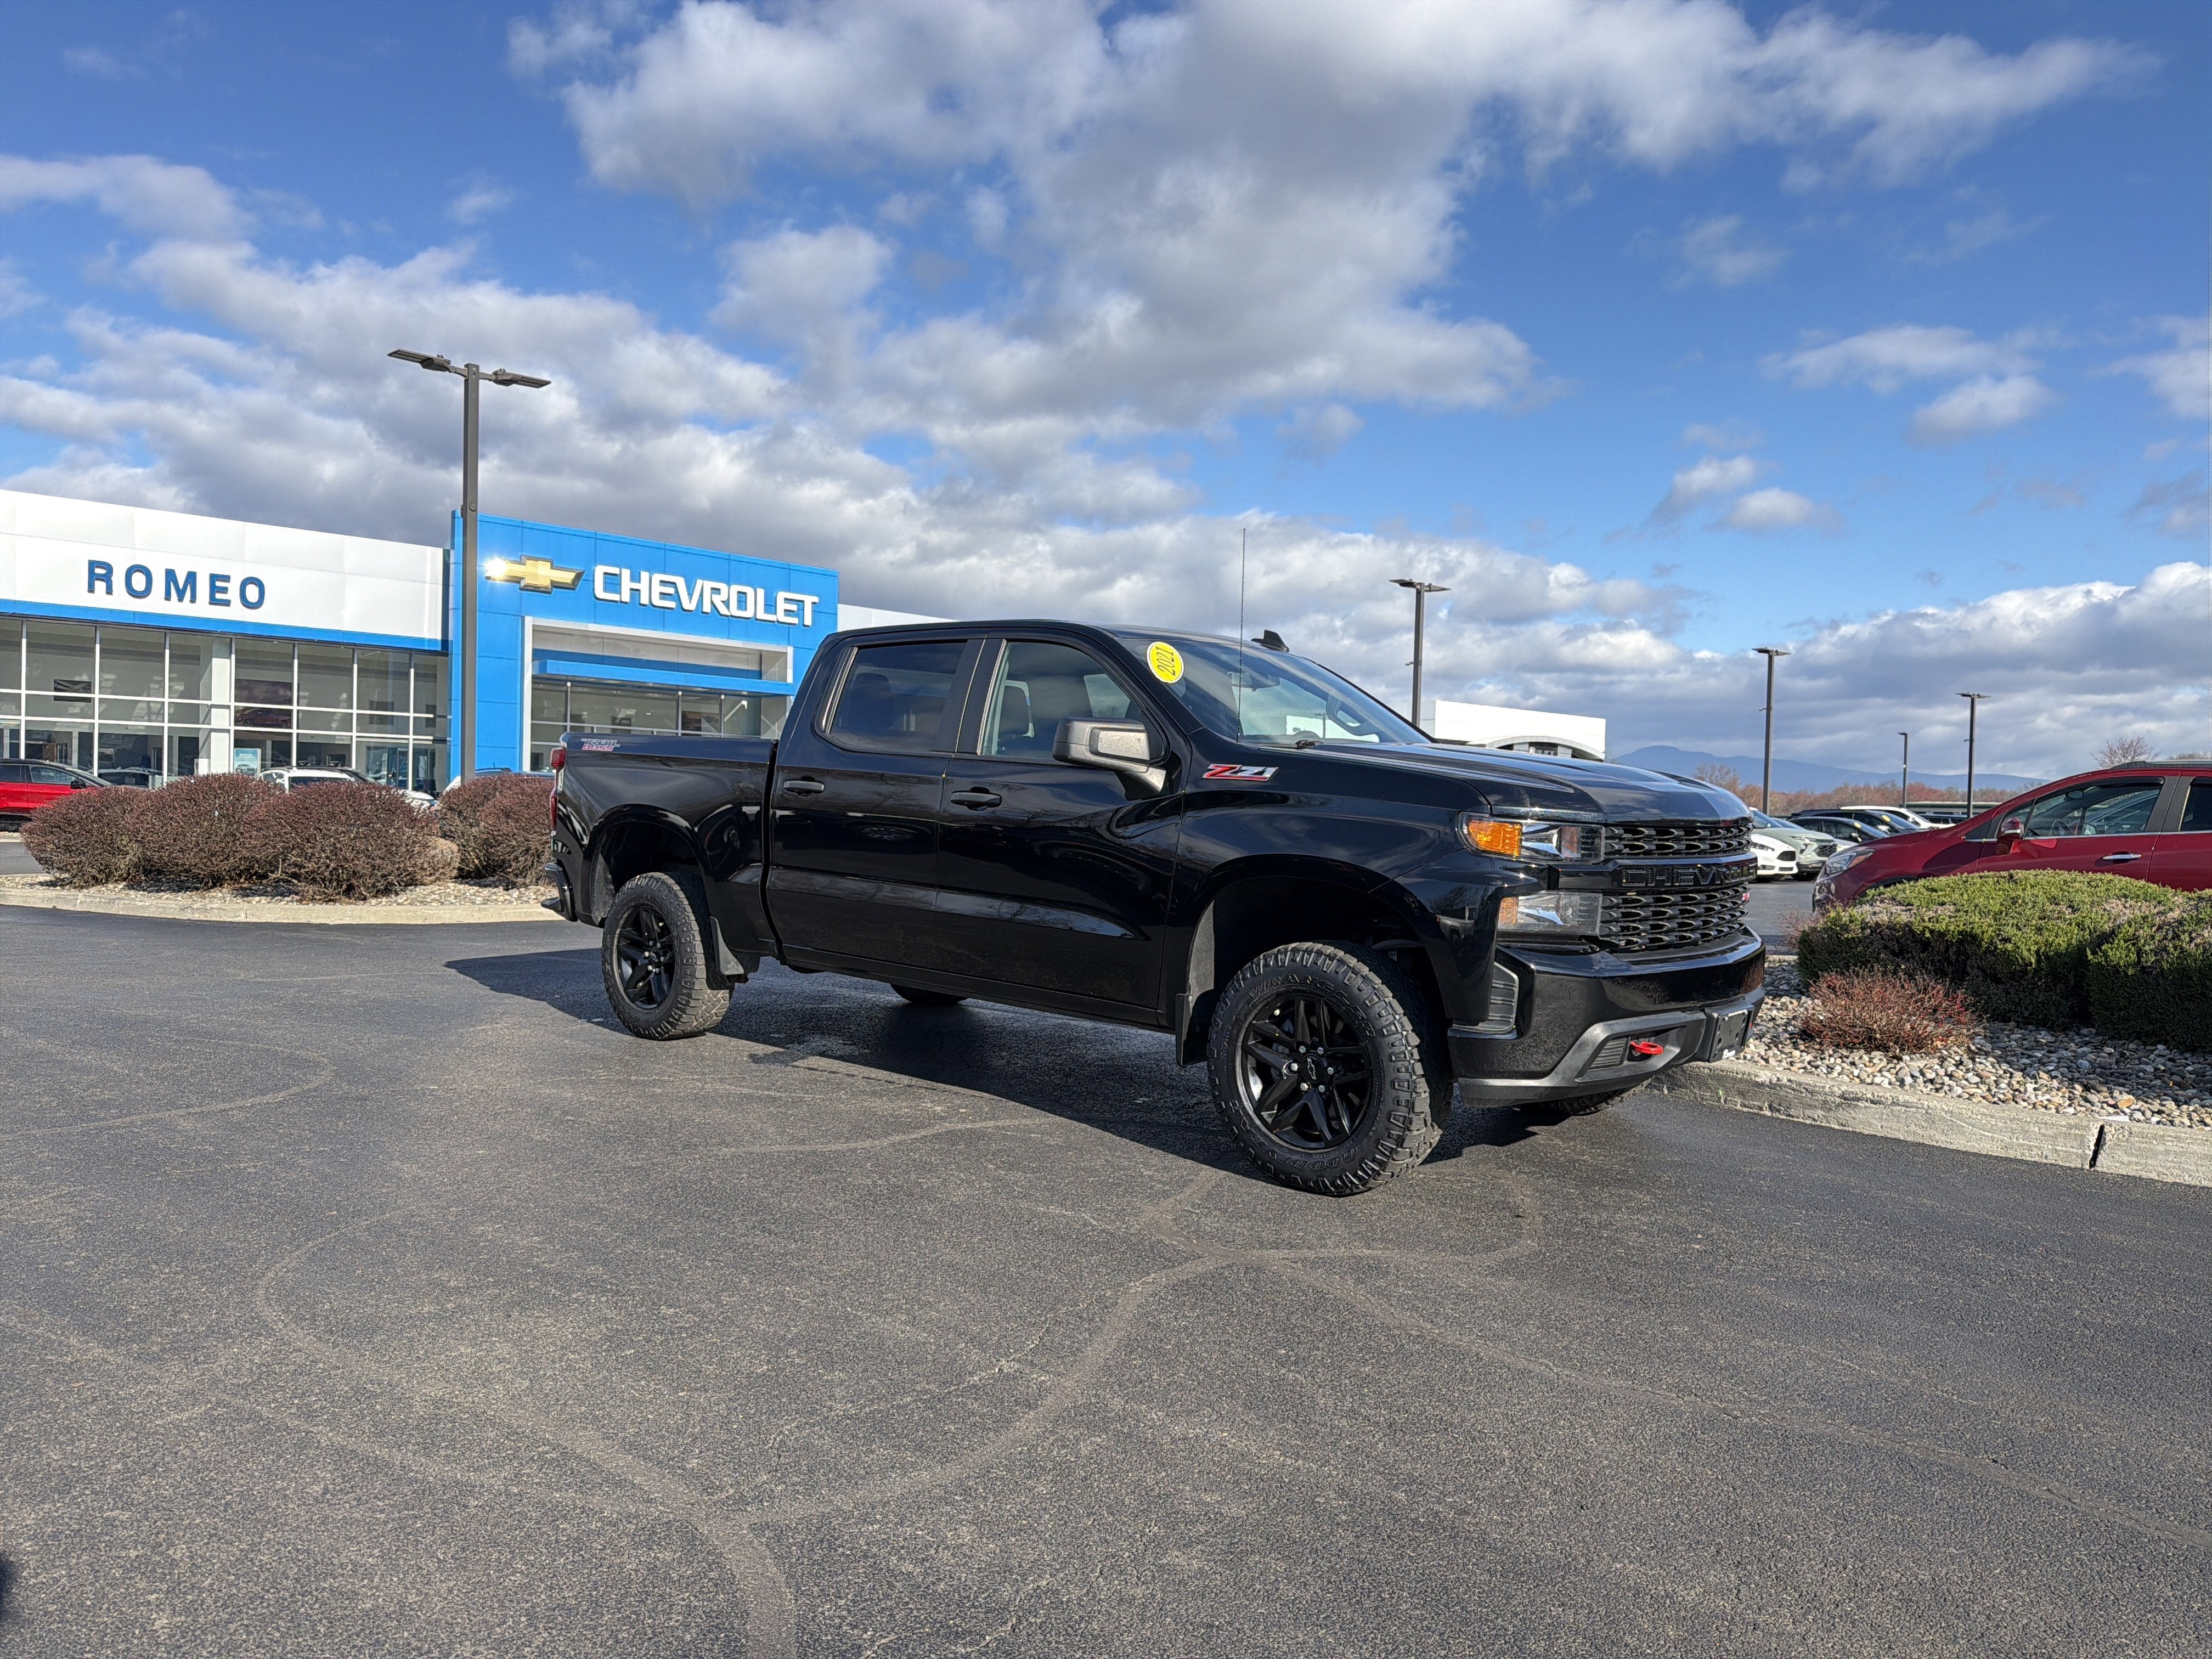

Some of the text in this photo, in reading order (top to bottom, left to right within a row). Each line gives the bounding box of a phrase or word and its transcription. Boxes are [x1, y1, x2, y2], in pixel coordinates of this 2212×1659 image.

[87, 560, 265, 610] ROMEO
[594, 565, 819, 627] CHEVROLET
[1155, 646, 1176, 676] 2021
[581, 738, 620, 747] TRAIL
[1201, 763, 1279, 781] Z71
